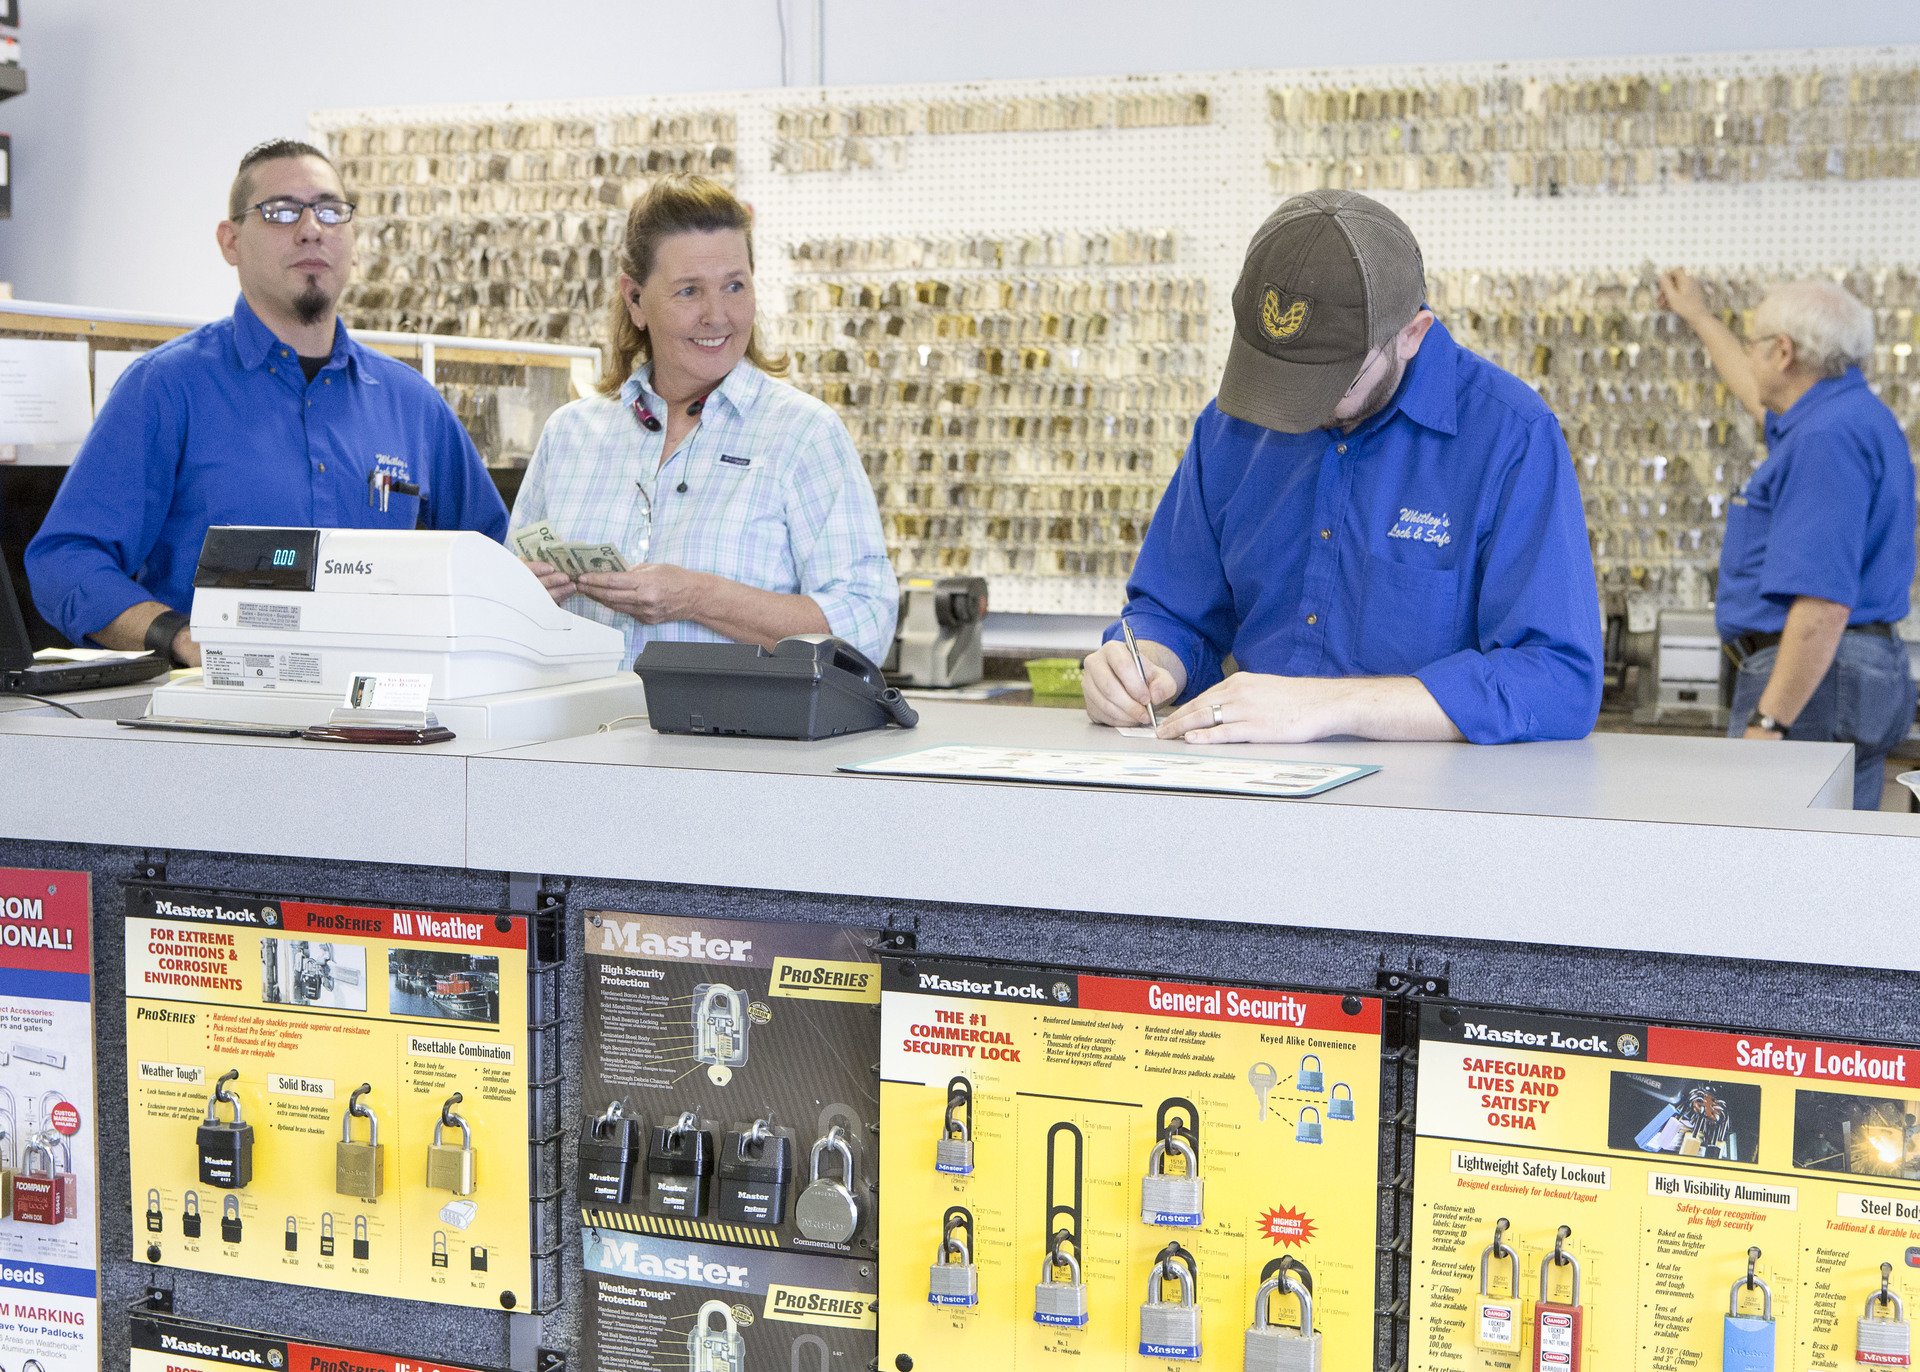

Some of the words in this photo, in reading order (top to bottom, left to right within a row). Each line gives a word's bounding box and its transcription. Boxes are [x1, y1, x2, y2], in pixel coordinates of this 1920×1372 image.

[1400, 508, 1451, 529] Whitley's
[1387, 523, 1411, 538] Lock
[1413, 526, 1423, 539] &
[1424, 530, 1451, 547] Safe
[0, 897, 42, 920] OM
[156, 901, 213, 918] Master
[393, 912, 412, 935] All
[416, 914, 483, 940] Weather
[151, 928, 174, 941] FOR
[179, 931, 234, 946] EXTREME
[148, 943, 224, 959] CONDITIONS
[229, 950, 238, 960] &
[159, 959, 227, 974] CORROSIVE
[600, 964, 622, 977] High
[625, 967, 665, 980] Security
[145, 972, 242, 990] ENVIRONMENTS
[600, 976, 650, 988] Protection
[919, 974, 991, 994] Master
[601, 990, 622, 998] Hardened
[1149, 985, 1220, 1015] General
[1227, 991, 1306, 1026] Security
[23, 1017, 52, 1026] securing
[213, 1013, 238, 1023] Hardened
[239, 1015, 251, 1023] steel
[252, 1017, 264, 1026] alloy
[266, 1018, 288, 1027] shackles
[289, 1020, 308, 1030] provide
[310, 1023, 331, 1032] superior
[343, 1026, 370, 1035] resistance
[935, 1010, 964, 1024] THE
[969, 1014, 987, 1026] #1
[1043, 1016, 1070, 1025] Reinforced
[1071, 1019, 1096, 1027] laminated
[1097, 1021, 1110, 1029] steel
[1111, 1022, 1124, 1031] body
[910, 1024, 1014, 1045] COMMERCIAL
[1145, 1025, 1170, 1034] Hardened
[1171, 1028, 1184, 1036] steel
[1185, 1029, 1198, 1038] alloy
[1199, 1031, 1221, 1039] shackles
[1464, 1023, 1547, 1046] Master
[412, 1039, 456, 1055] Resettable
[459, 1043, 511, 1060] Combination
[1260, 1033, 1283, 1045] Keyed
[1286, 1036, 1305, 1047] Alike
[1308, 1038, 1356, 1051] Convenience
[221, 1046, 239, 1054] models
[250, 1049, 275, 1058] rekeyable
[903, 1039, 975, 1057] SECURITY
[981, 1047, 1020, 1062] LOCK
[1463, 1057, 1566, 1080] SAFEGUARD
[1736, 1040, 1806, 1076] Safety
[1815, 1047, 1906, 1081] Lockout
[142, 1064, 175, 1078] Weather
[1144, 1065, 1171, 1074] Laminated
[1172, 1068, 1186, 1076] brass
[1188, 1069, 1211, 1079] padlocks
[1213, 1071, 1236, 1080] available
[279, 1078, 298, 1091] Solid
[301, 1081, 323, 1093] Brass
[1468, 1076, 1514, 1092] LIVES
[1520, 1082, 1558, 1096] AND
[1481, 1095, 1549, 1113] SATISFY
[1488, 1113, 1536, 1130] OSHA
[205, 1156, 233, 1166] Master
[589, 1173, 620, 1182] Master
[1458, 1155, 1519, 1176] Lightweight
[1523, 1162, 1557, 1181] Safety
[1562, 1167, 1605, 1184] Lockout
[658, 1182, 688, 1192] Master
[1457, 1178, 1489, 1190] Designed
[1491, 1183, 1529, 1196] exclusively
[1531, 1187, 1541, 1196] for
[1543, 1190, 1597, 1203] lockout/tagout
[1656, 1177, 1679, 1194] High
[1684, 1180, 1730, 1200] Visibility
[1735, 1185, 1790, 1205] Aluminum
[738, 1191, 769, 1201] Master
[1677, 1203, 1721, 1216] Safety-color
[1724, 1210, 1766, 1221] recognition
[1861, 1199, 1891, 1216] Steel
[1896, 1203, 1920, 1221] Bod
[1273, 1217, 1301, 1227] HIGHEST
[1688, 1216, 1703, 1225] plus
[1705, 1217, 1721, 1228] high
[1724, 1221, 1753, 1232] security
[1826, 1220, 1867, 1234] Traditional
[1869, 1226, 1875, 1234] &
[1878, 1227, 1907, 1238] durable
[1271, 1226, 1303, 1235] SECURITY
[1658, 1229, 1676, 1237] Baked
[1687, 1232, 1702, 1240] finish
[793, 1238, 835, 1249] Commercial
[836, 1242, 850, 1250] Use
[598, 1282, 636, 1295] Weather
[1656, 1288, 1694, 1299] environments
[598, 1293, 647, 1308] Protection
[15, 1305, 85, 1325] MARKING
[1041, 1314, 1073, 1323] Master
[1430, 1317, 1443, 1326] High
[1444, 1319, 1466, 1328] security
[18, 1324, 38, 1333] Your
[41, 1327, 83, 1339] Padlocks
[161, 1335, 219, 1357] Master
[1148, 1346, 1187, 1355] Master
[1429, 1341, 1452, 1350] 100,000
[1811, 1360, 1838, 1368] available
[1864, 1353, 1903, 1363] Master
